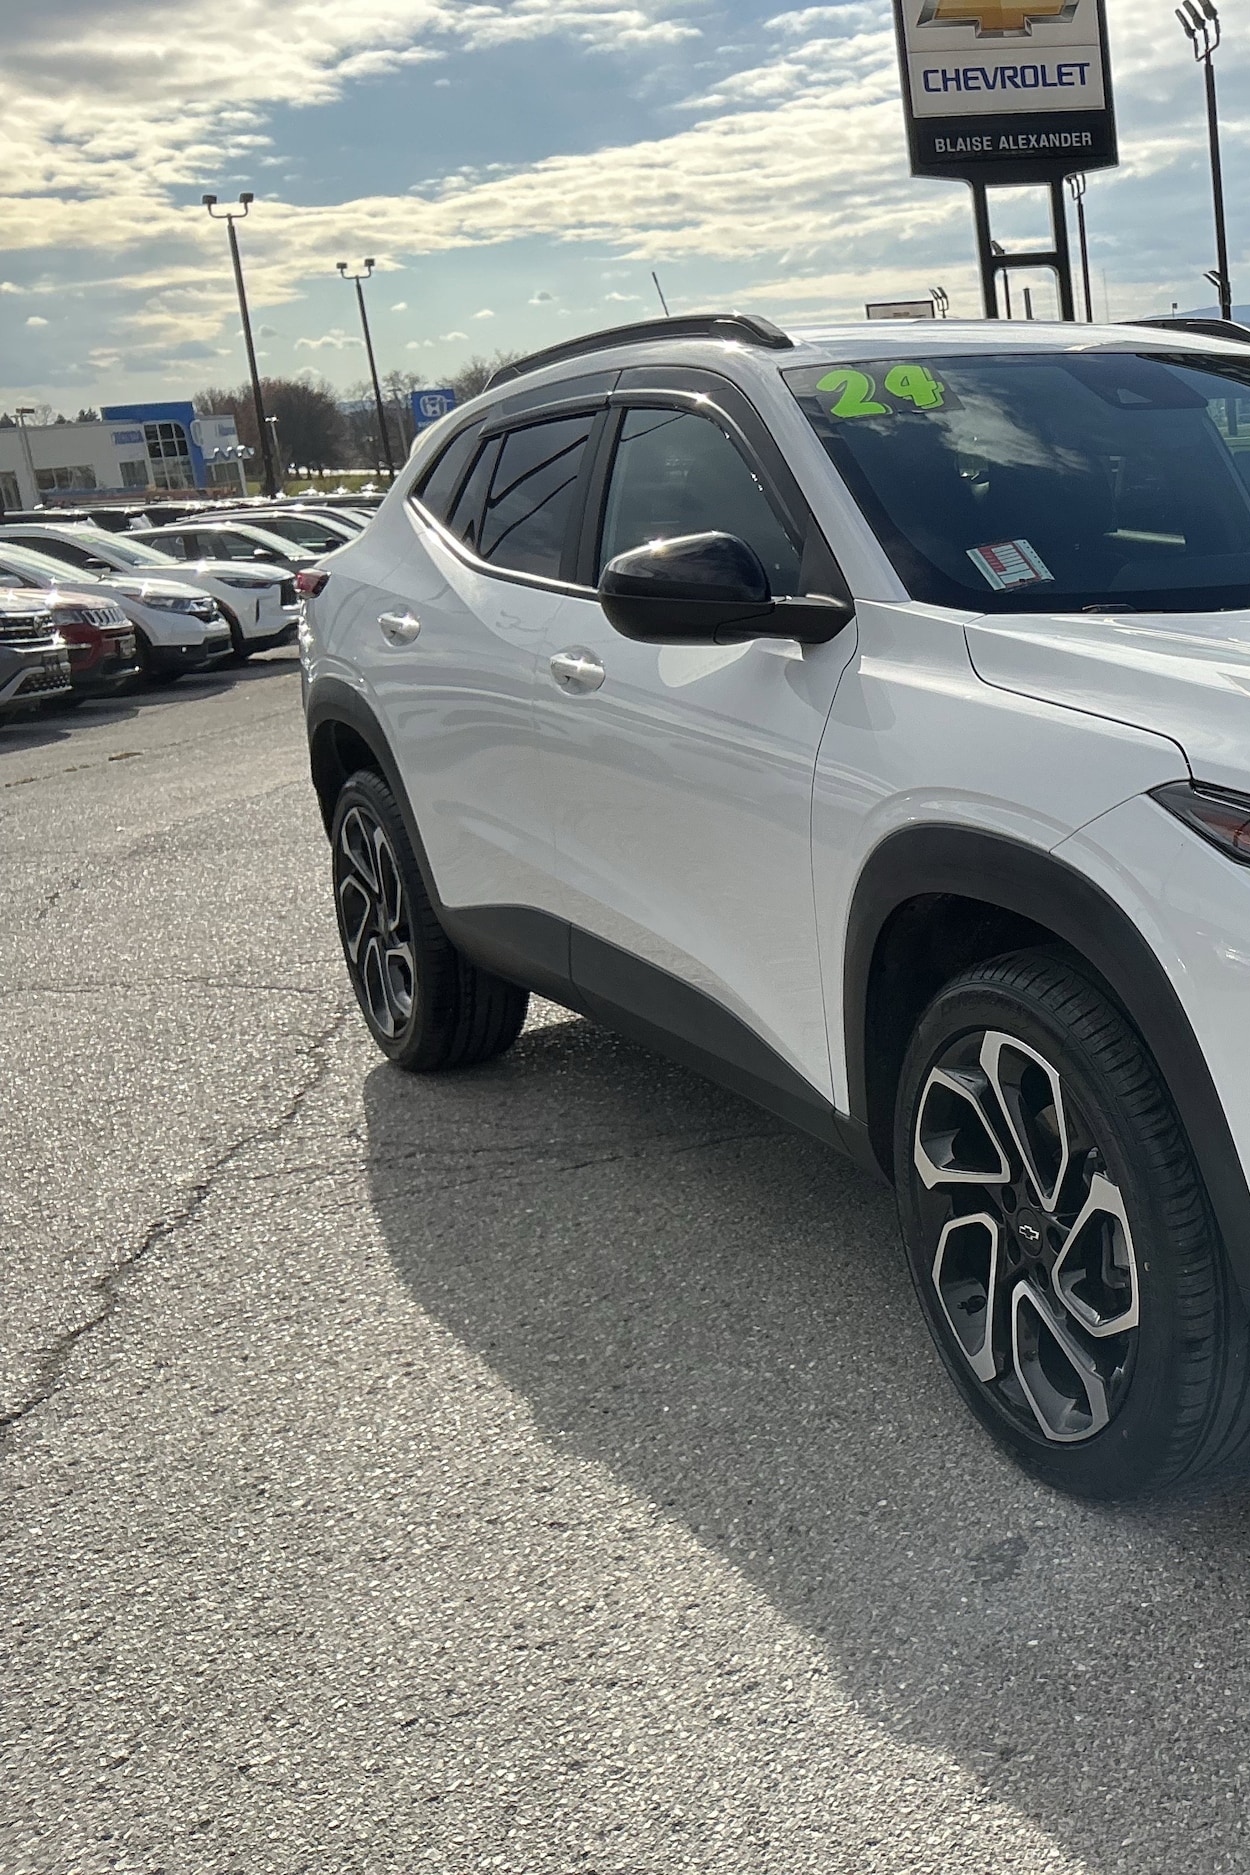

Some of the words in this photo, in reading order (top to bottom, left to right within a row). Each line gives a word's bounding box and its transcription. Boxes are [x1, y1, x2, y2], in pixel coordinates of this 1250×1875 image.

[923, 63, 1090, 92] CHEVROLET
[935, 136, 992, 152] BLAISE
[999, 132, 1092, 149] ALEXANDER
[815, 364, 945, 418] 24
